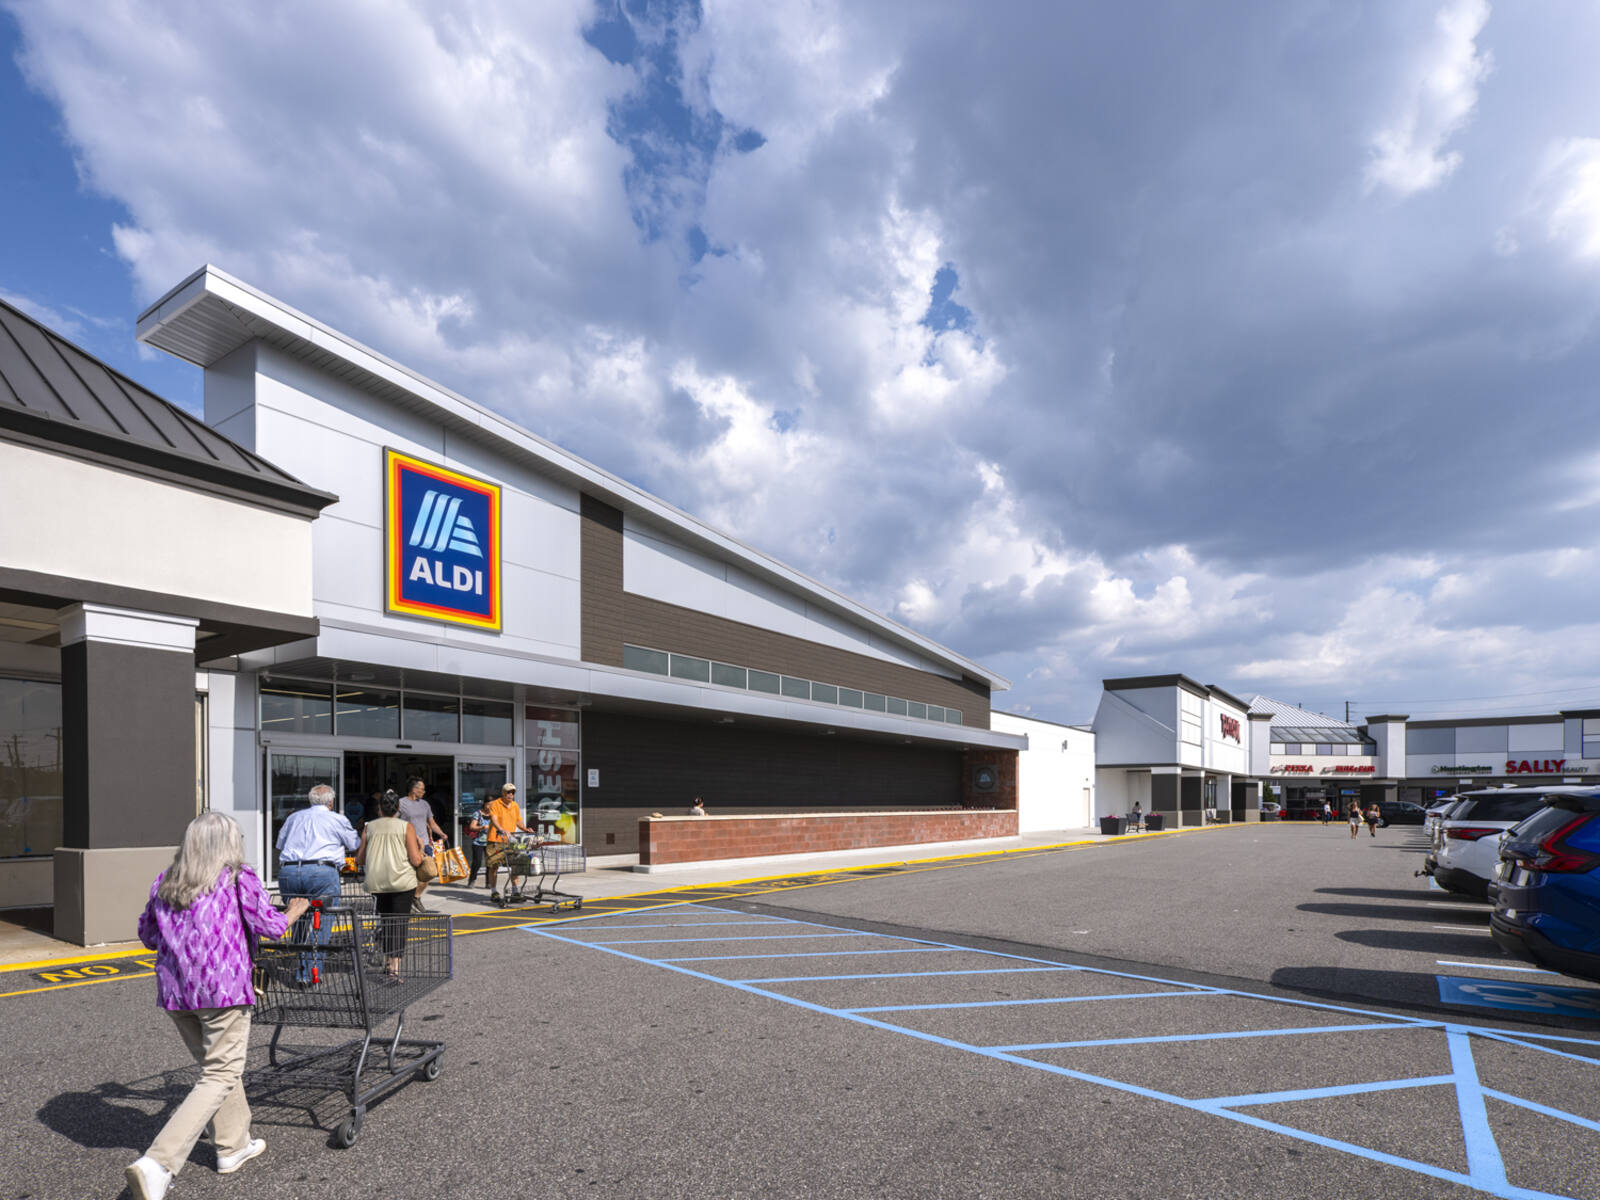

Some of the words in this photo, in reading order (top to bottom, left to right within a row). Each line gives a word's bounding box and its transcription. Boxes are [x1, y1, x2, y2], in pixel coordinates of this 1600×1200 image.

[409, 556, 483, 595] ALDI
[537, 720, 562, 842] FRESH
[1505, 760, 1566, 774] SALLY
[38, 965, 120, 982] NO
